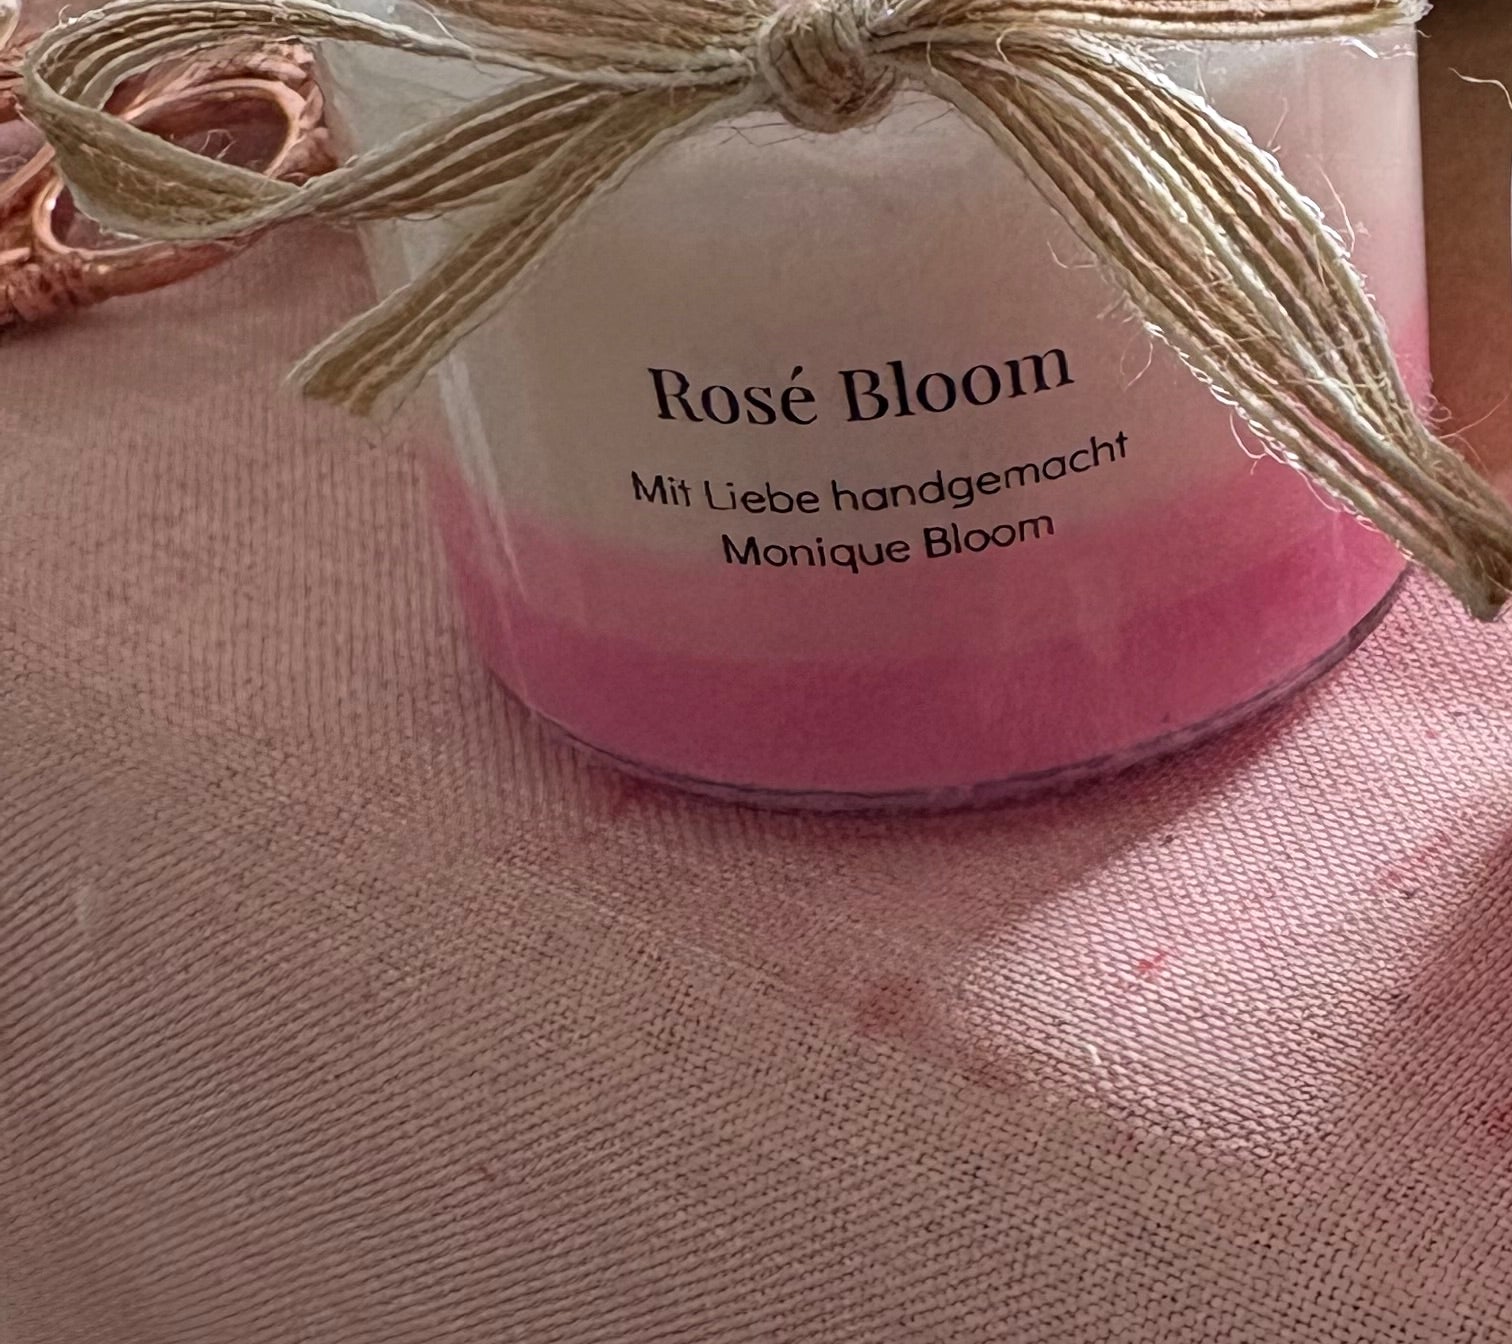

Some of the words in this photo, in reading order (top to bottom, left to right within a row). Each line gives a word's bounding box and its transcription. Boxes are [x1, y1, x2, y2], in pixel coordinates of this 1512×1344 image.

[647, 365, 818, 426] Rosé
[837, 347, 1075, 423] Bloom
[630, 470, 692, 508] Mit
[703, 479, 820, 514] Liebe
[830, 430, 1129, 511] handgemacht
[721, 533, 911, 575] Monique
[923, 515, 1055, 559] Bloom
